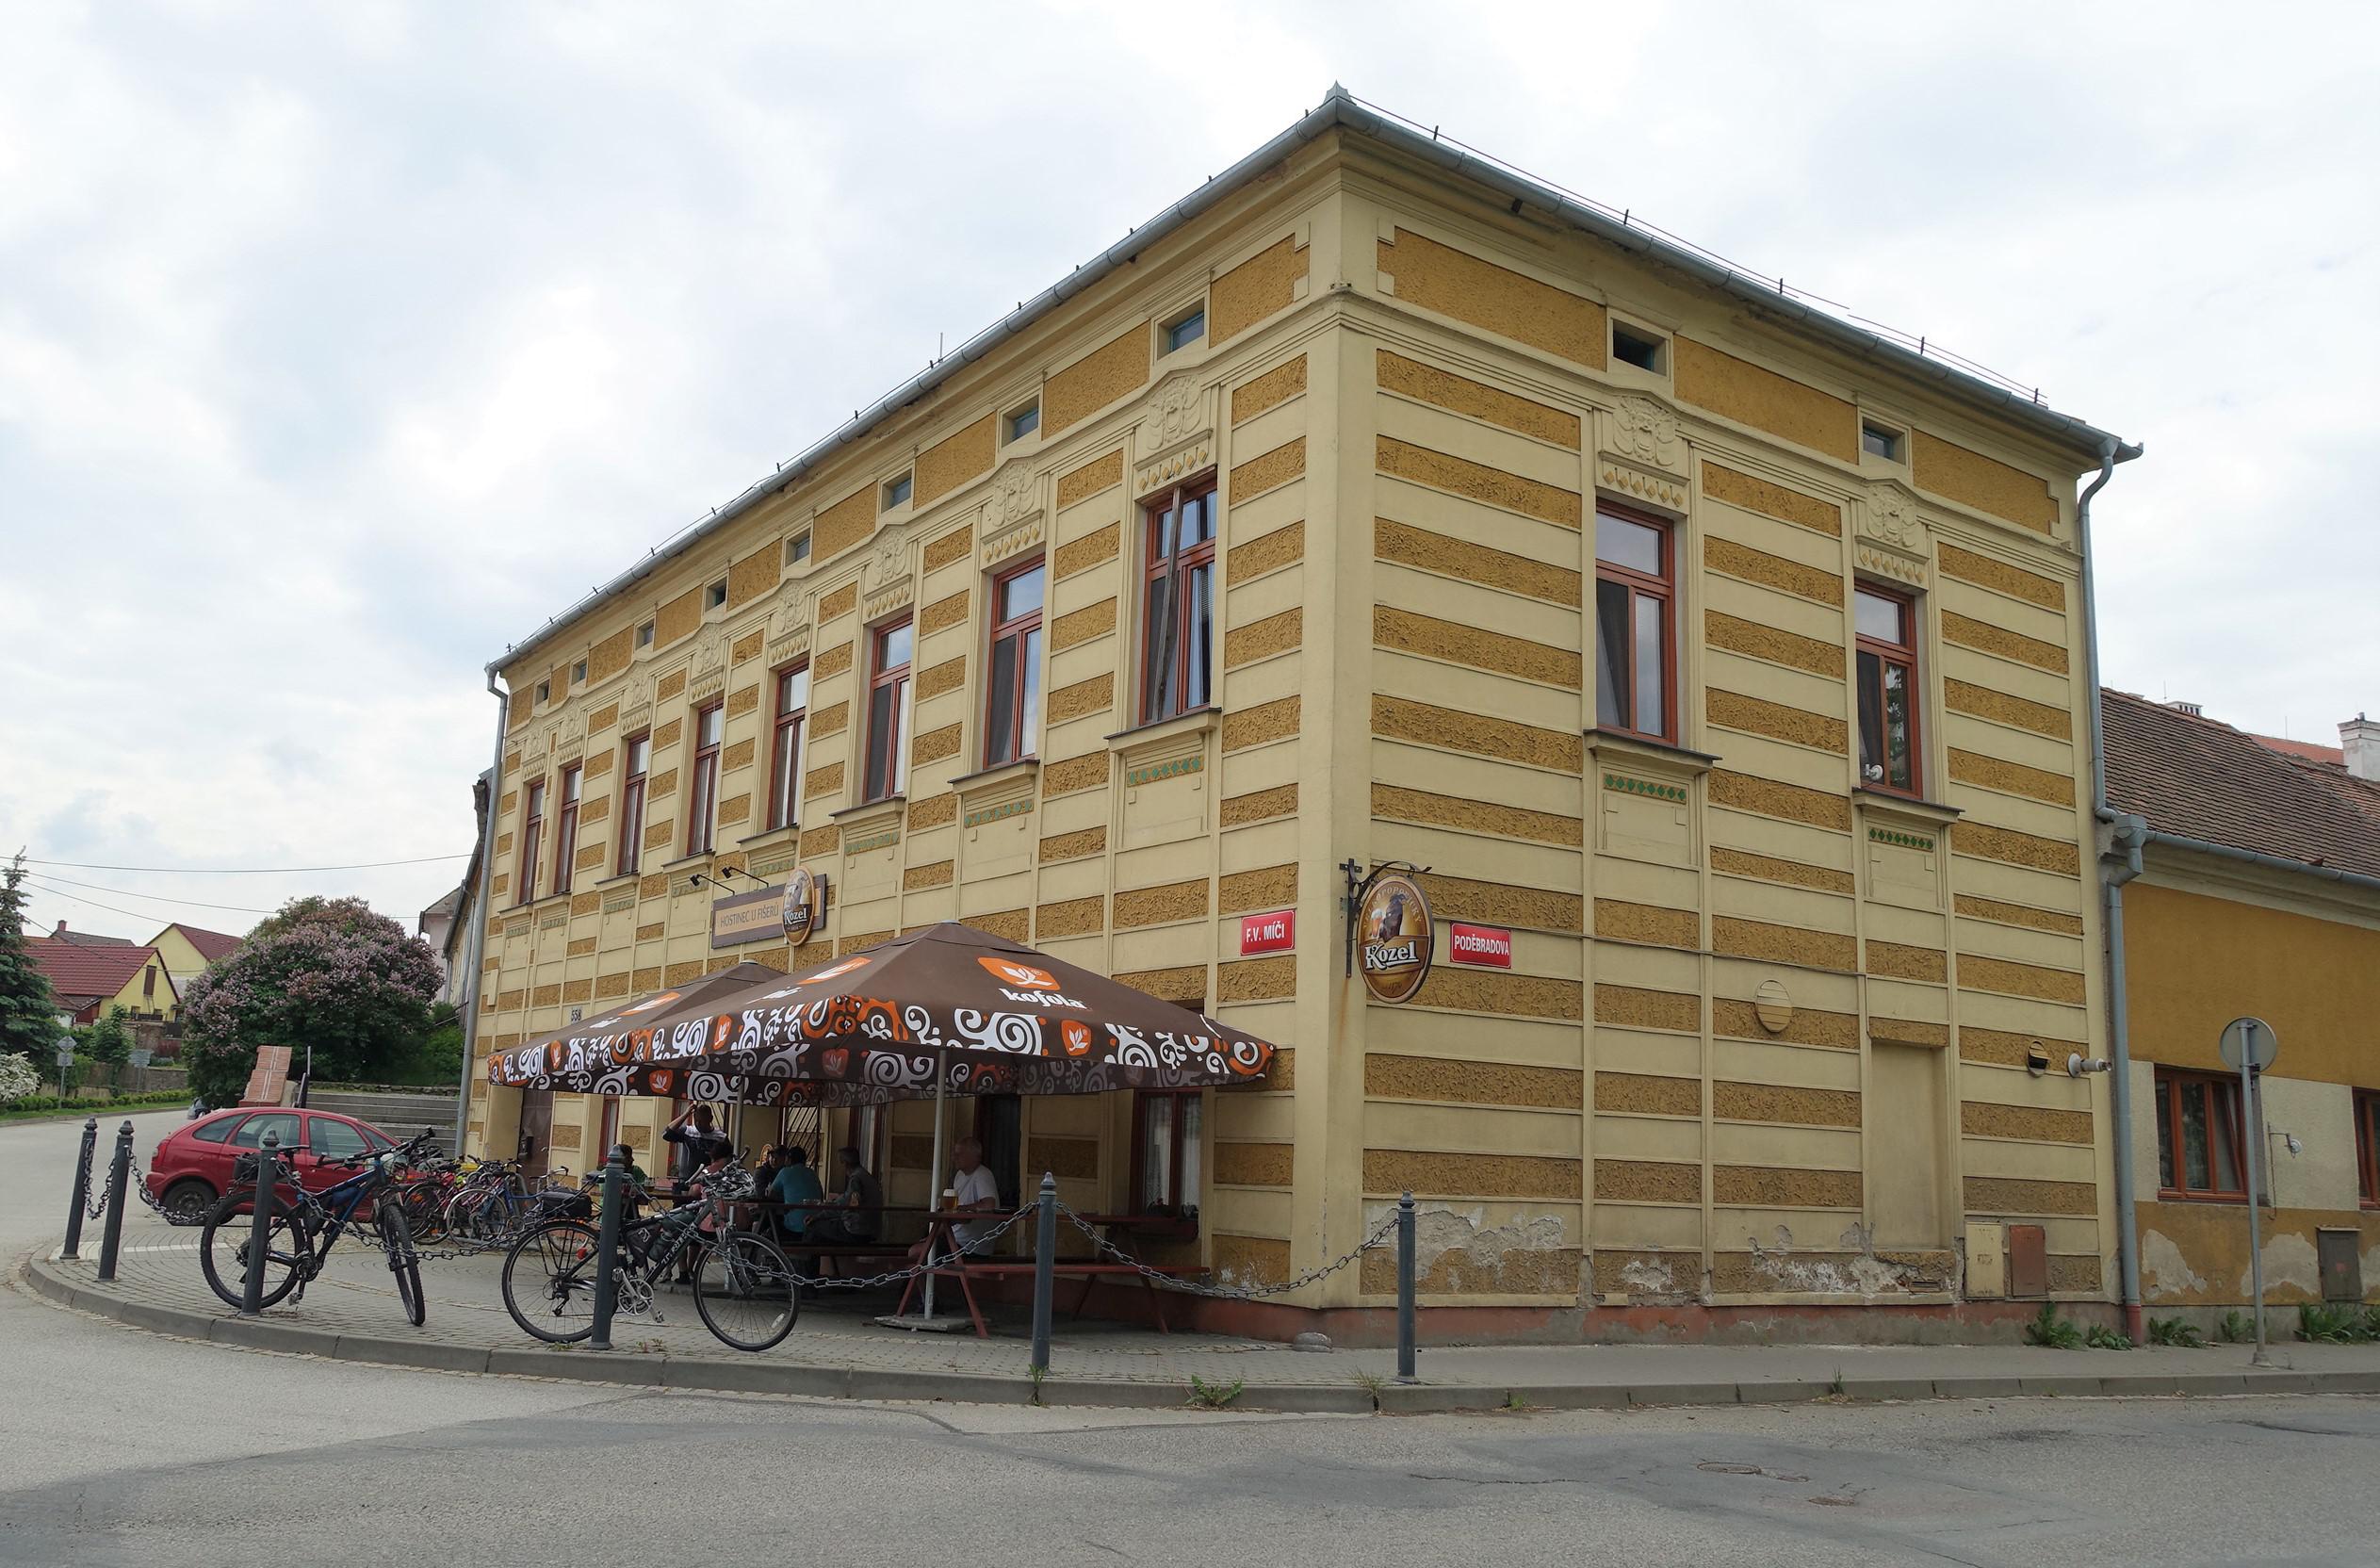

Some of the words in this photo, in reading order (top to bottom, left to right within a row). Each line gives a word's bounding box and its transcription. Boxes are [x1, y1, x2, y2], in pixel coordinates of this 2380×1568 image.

[720, 910, 750, 927] HOSTINEC
[751, 910, 757, 922] U
[784, 907, 807, 925] Kozel
[1246, 927, 1262, 943] F.V.
[1263, 921, 1284, 940] MÍČI
[1365, 940, 1419, 970] Kozel
[1454, 933, 1509, 956] PODĚBRADOVA
[999, 988, 1088, 1009] kofola
